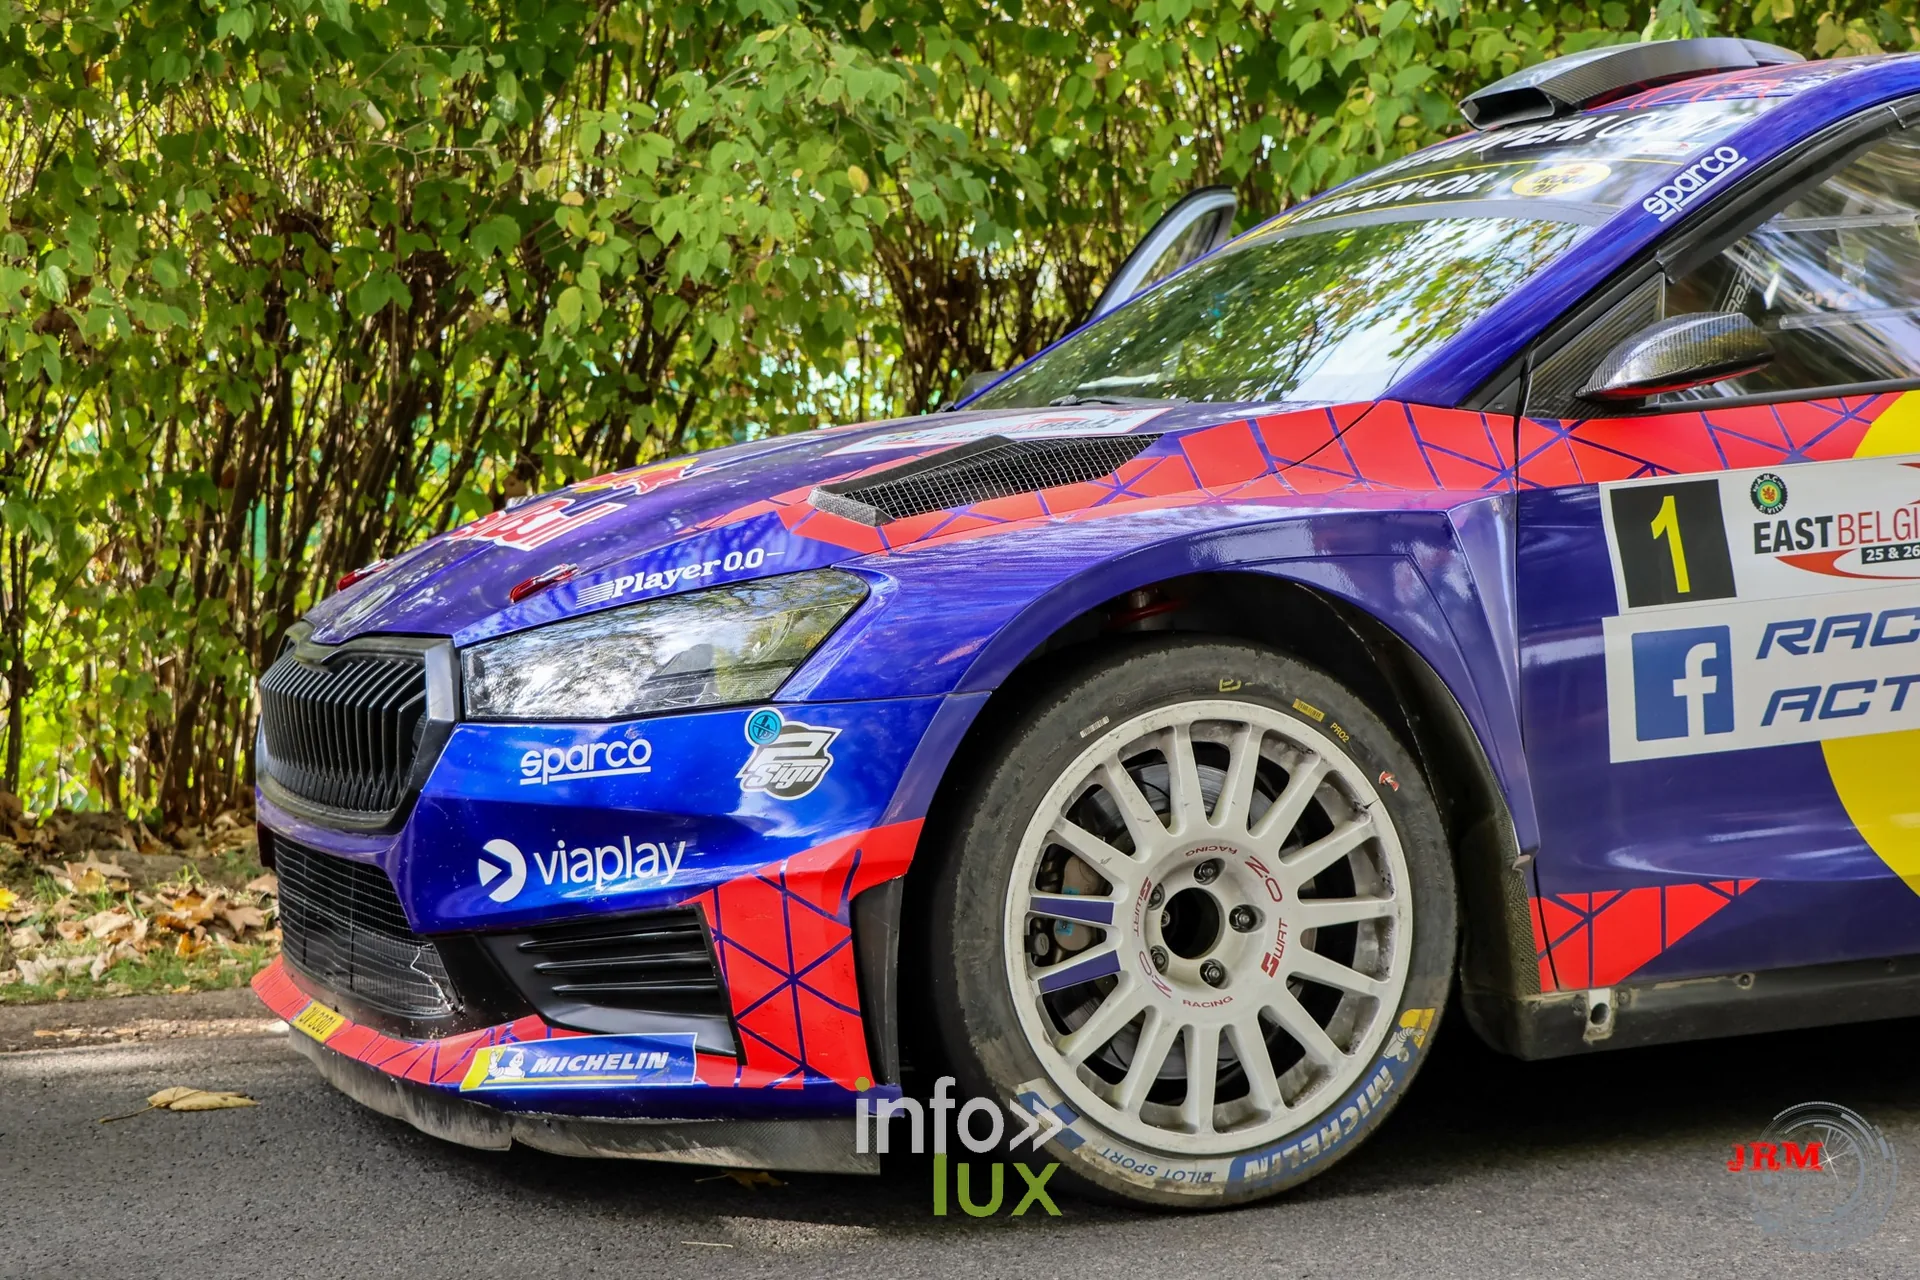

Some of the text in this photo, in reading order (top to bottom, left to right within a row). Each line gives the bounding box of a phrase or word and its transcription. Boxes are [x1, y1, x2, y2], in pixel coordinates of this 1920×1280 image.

[1643, 146, 1747, 222] sparco
[1650, 495, 1690, 594] 1
[1866, 545, 1920, 561] 25 & 26
[611, 559, 721, 598] Player
[1755, 606, 1920, 660] RAC
[1760, 674, 1920, 727] ACT
[1330, 722, 1350, 743] PRO2
[520, 738, 652, 785] sparco
[744, 762, 823, 790] Sign
[533, 835, 686, 892] viaplay
[1185, 845, 1238, 858] RACING
[1183, 996, 1234, 1008] RACING
[530, 1052, 669, 1073] MICHELIN
[1243, 1065, 1395, 1181] MICHELIN
[1099, 1147, 1213, 1183] PILOT SPORT
